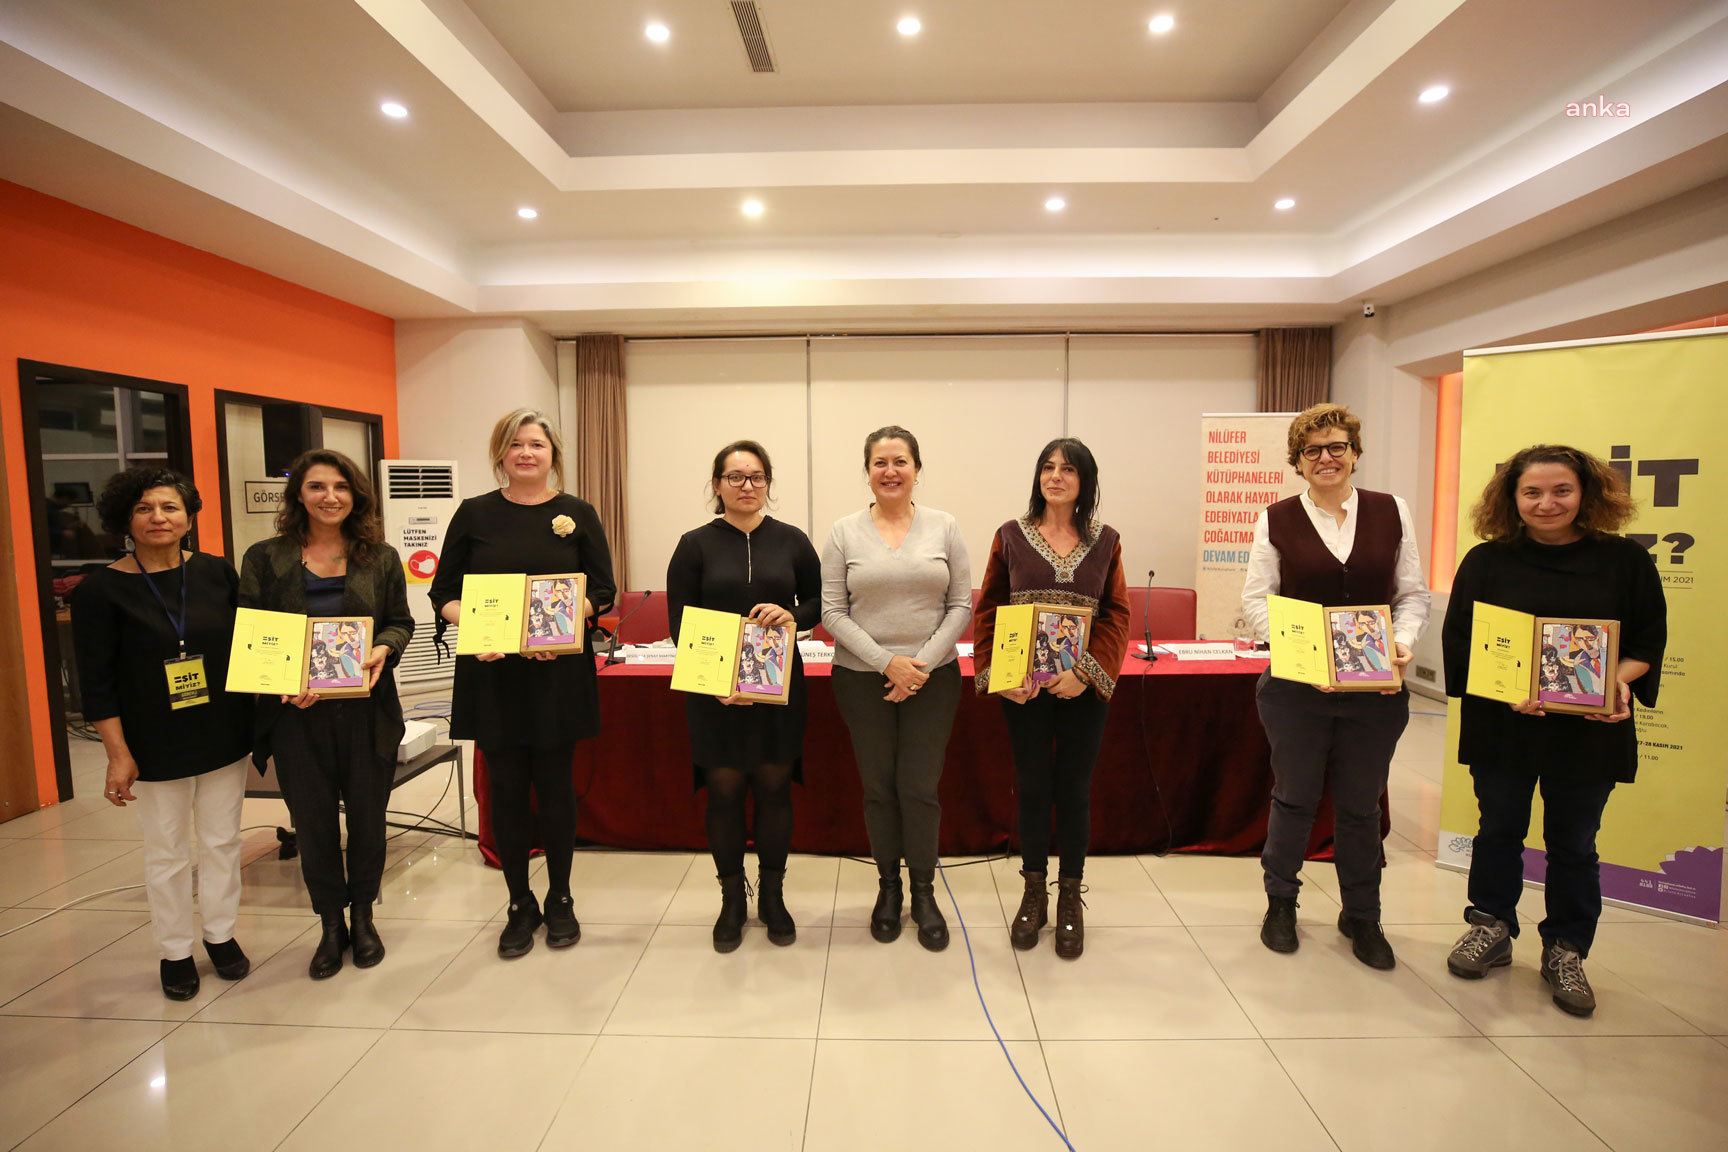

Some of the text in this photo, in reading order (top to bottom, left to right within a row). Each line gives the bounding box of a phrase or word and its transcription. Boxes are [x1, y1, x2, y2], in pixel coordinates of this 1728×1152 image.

[1208, 429, 1247, 444] NİLÜFER
[1207, 449, 1260, 464] BELEDİYESİ
[1206, 469, 1284, 484] KÜTÜPHANELERİ
[1205, 490, 1279, 504] OLARAK HAYATI
[1202, 550, 1236, 563] DEVAM
[1673, 576, 1694, 584] 2021
